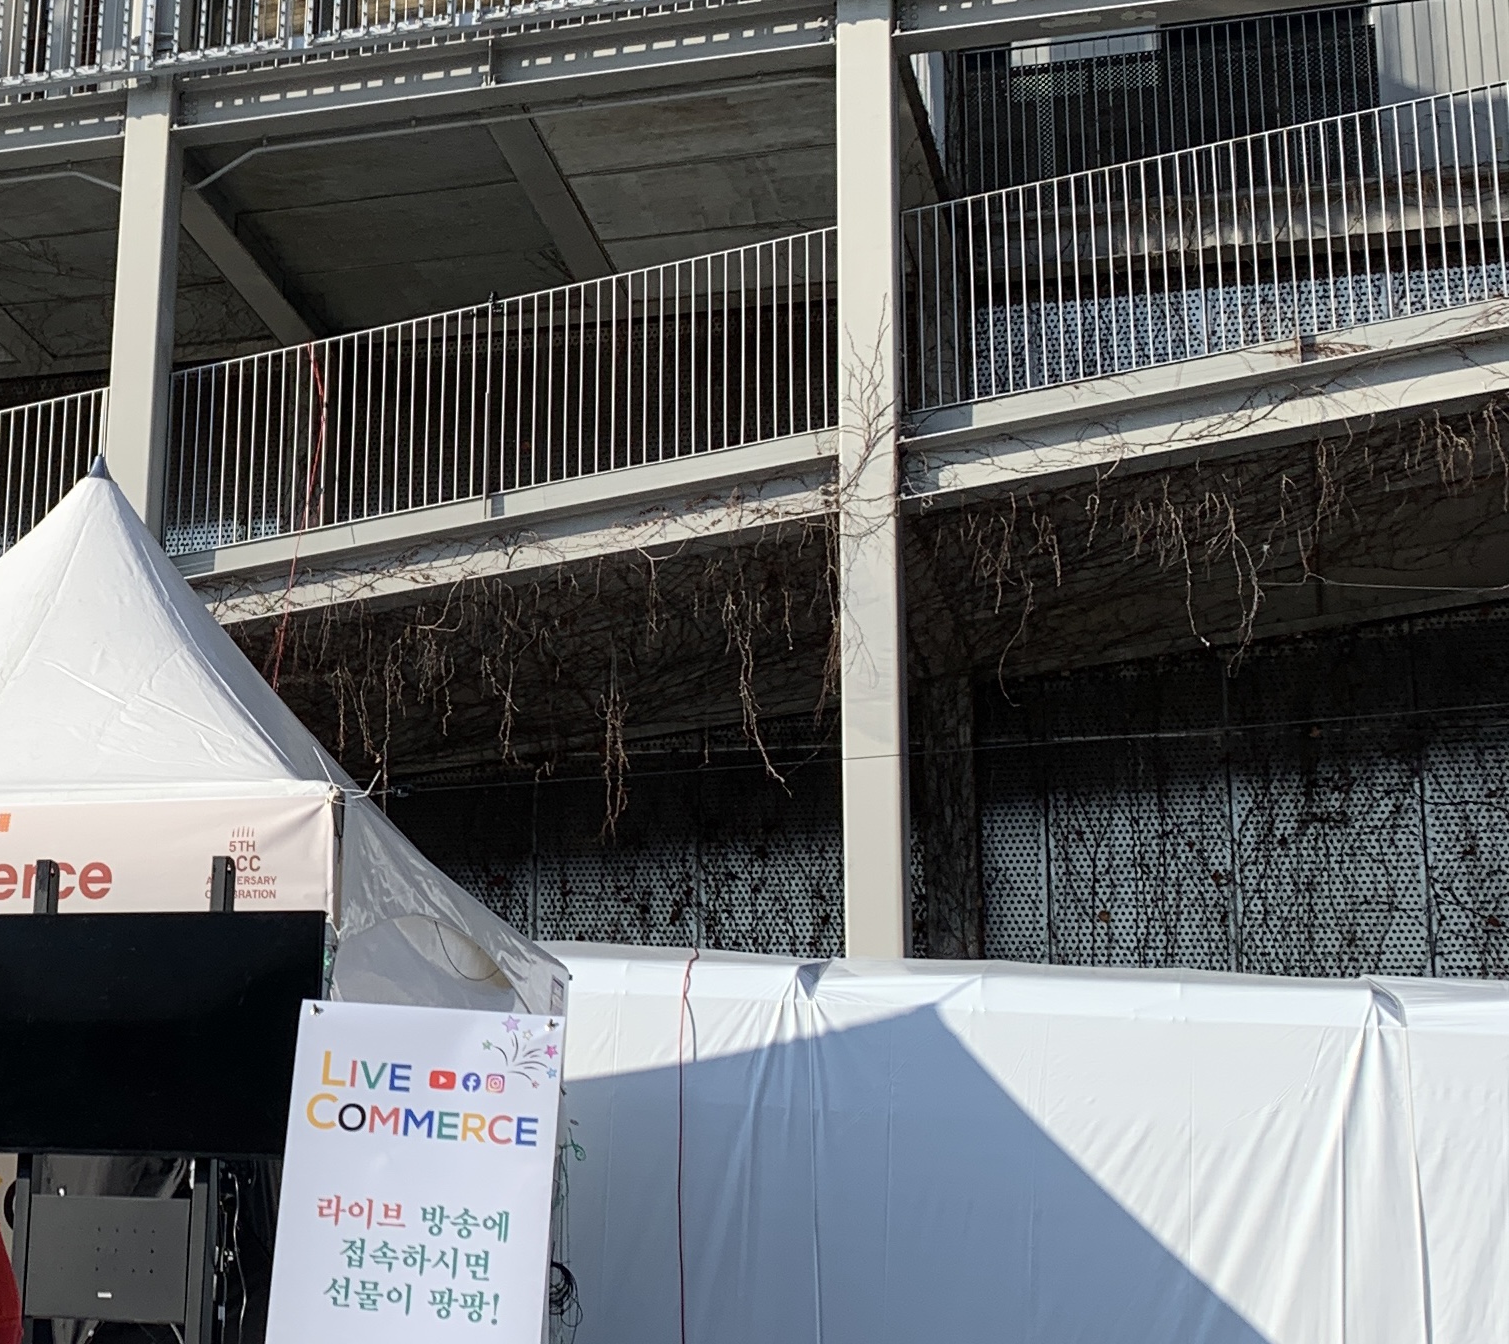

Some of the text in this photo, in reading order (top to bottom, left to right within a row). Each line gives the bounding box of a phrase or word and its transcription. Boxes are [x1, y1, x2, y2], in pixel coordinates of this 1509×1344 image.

[229, 840, 256, 853] 5TH
[321, 1050, 412, 1093] LIVE
[306, 1092, 539, 1147] COMMERCE
[317, 1194, 511, 1244] 라이브 방송에
[341, 1237, 490, 1282] 접속하시면
[323, 1276, 501, 1326] 선물이 팡팡!
